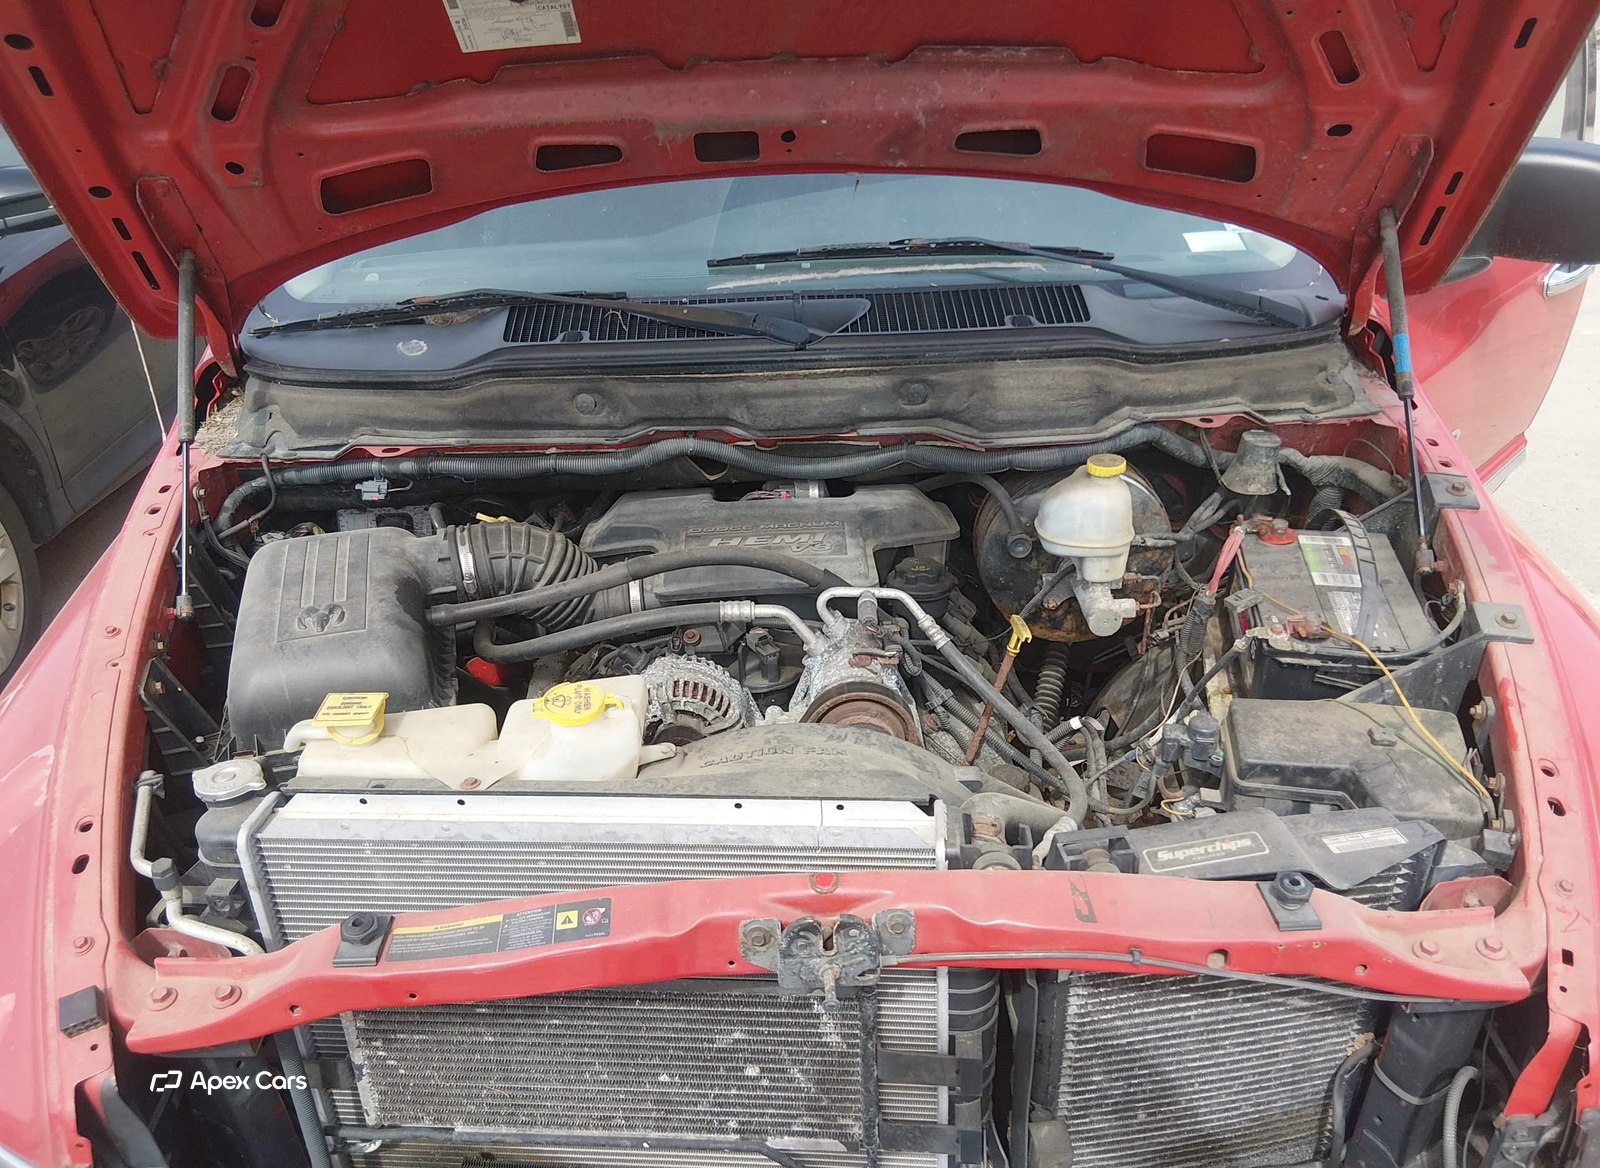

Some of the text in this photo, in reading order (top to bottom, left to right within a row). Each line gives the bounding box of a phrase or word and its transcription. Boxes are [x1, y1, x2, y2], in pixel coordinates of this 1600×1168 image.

[537, 3, 571, 11] CATALYST
[759, 520, 840, 531] MAGNUM
[709, 532, 827, 548] HEMI
[583, 687, 592, 711] WASHER
[699, 746, 849, 769] CAUTION FAN
[1157, 838, 1252, 862] Superchips
